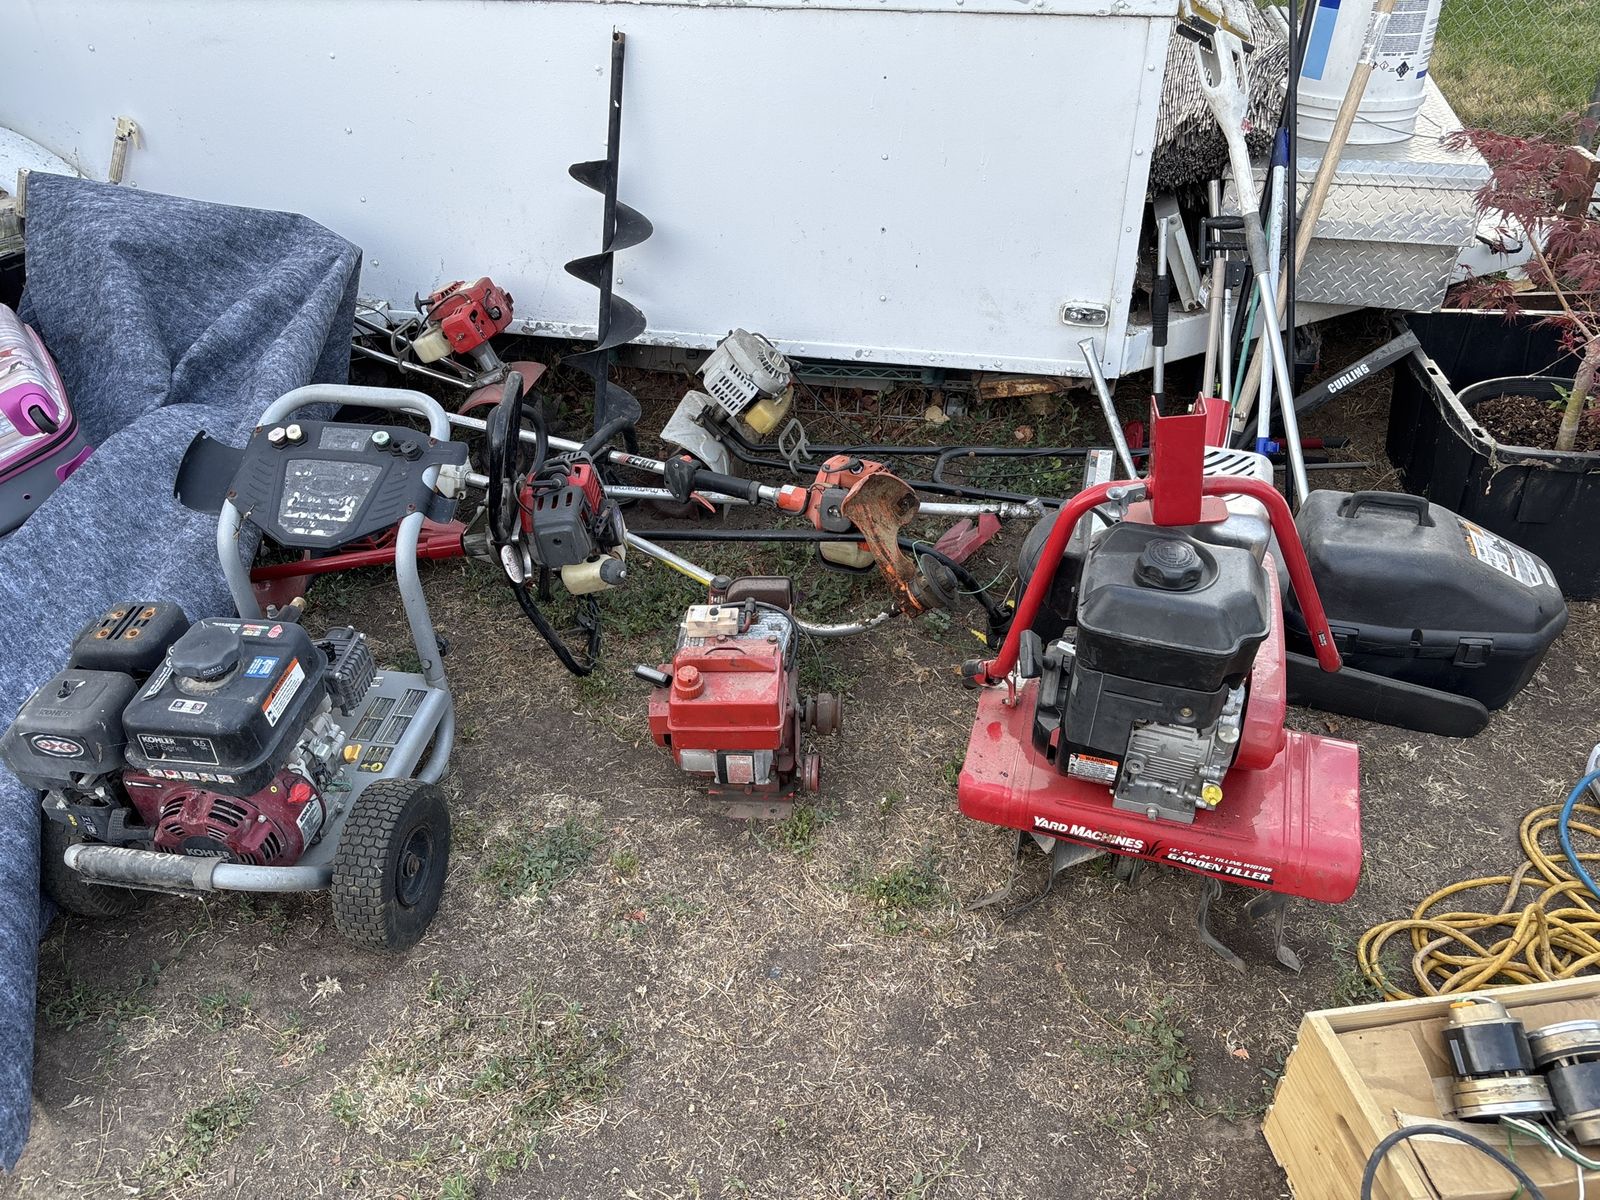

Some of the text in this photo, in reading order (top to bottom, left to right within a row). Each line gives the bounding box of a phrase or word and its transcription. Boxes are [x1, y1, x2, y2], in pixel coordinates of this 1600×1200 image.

[1327, 363, 1370, 394] CURLING
[627, 455, 658, 470] ECHO
[141, 736, 176, 745] KOHLER
[160, 743, 188, 753] Series
[1085, 755, 1113, 765] WARNING
[1033, 815, 1069, 832] YARD
[185, 847, 231, 859] KOHLER
[1167, 852, 1271, 882] GARDEN TILLER
[1214, 857, 1242, 867] TILLING
[1243, 862, 1273, 873] WIDTHS
